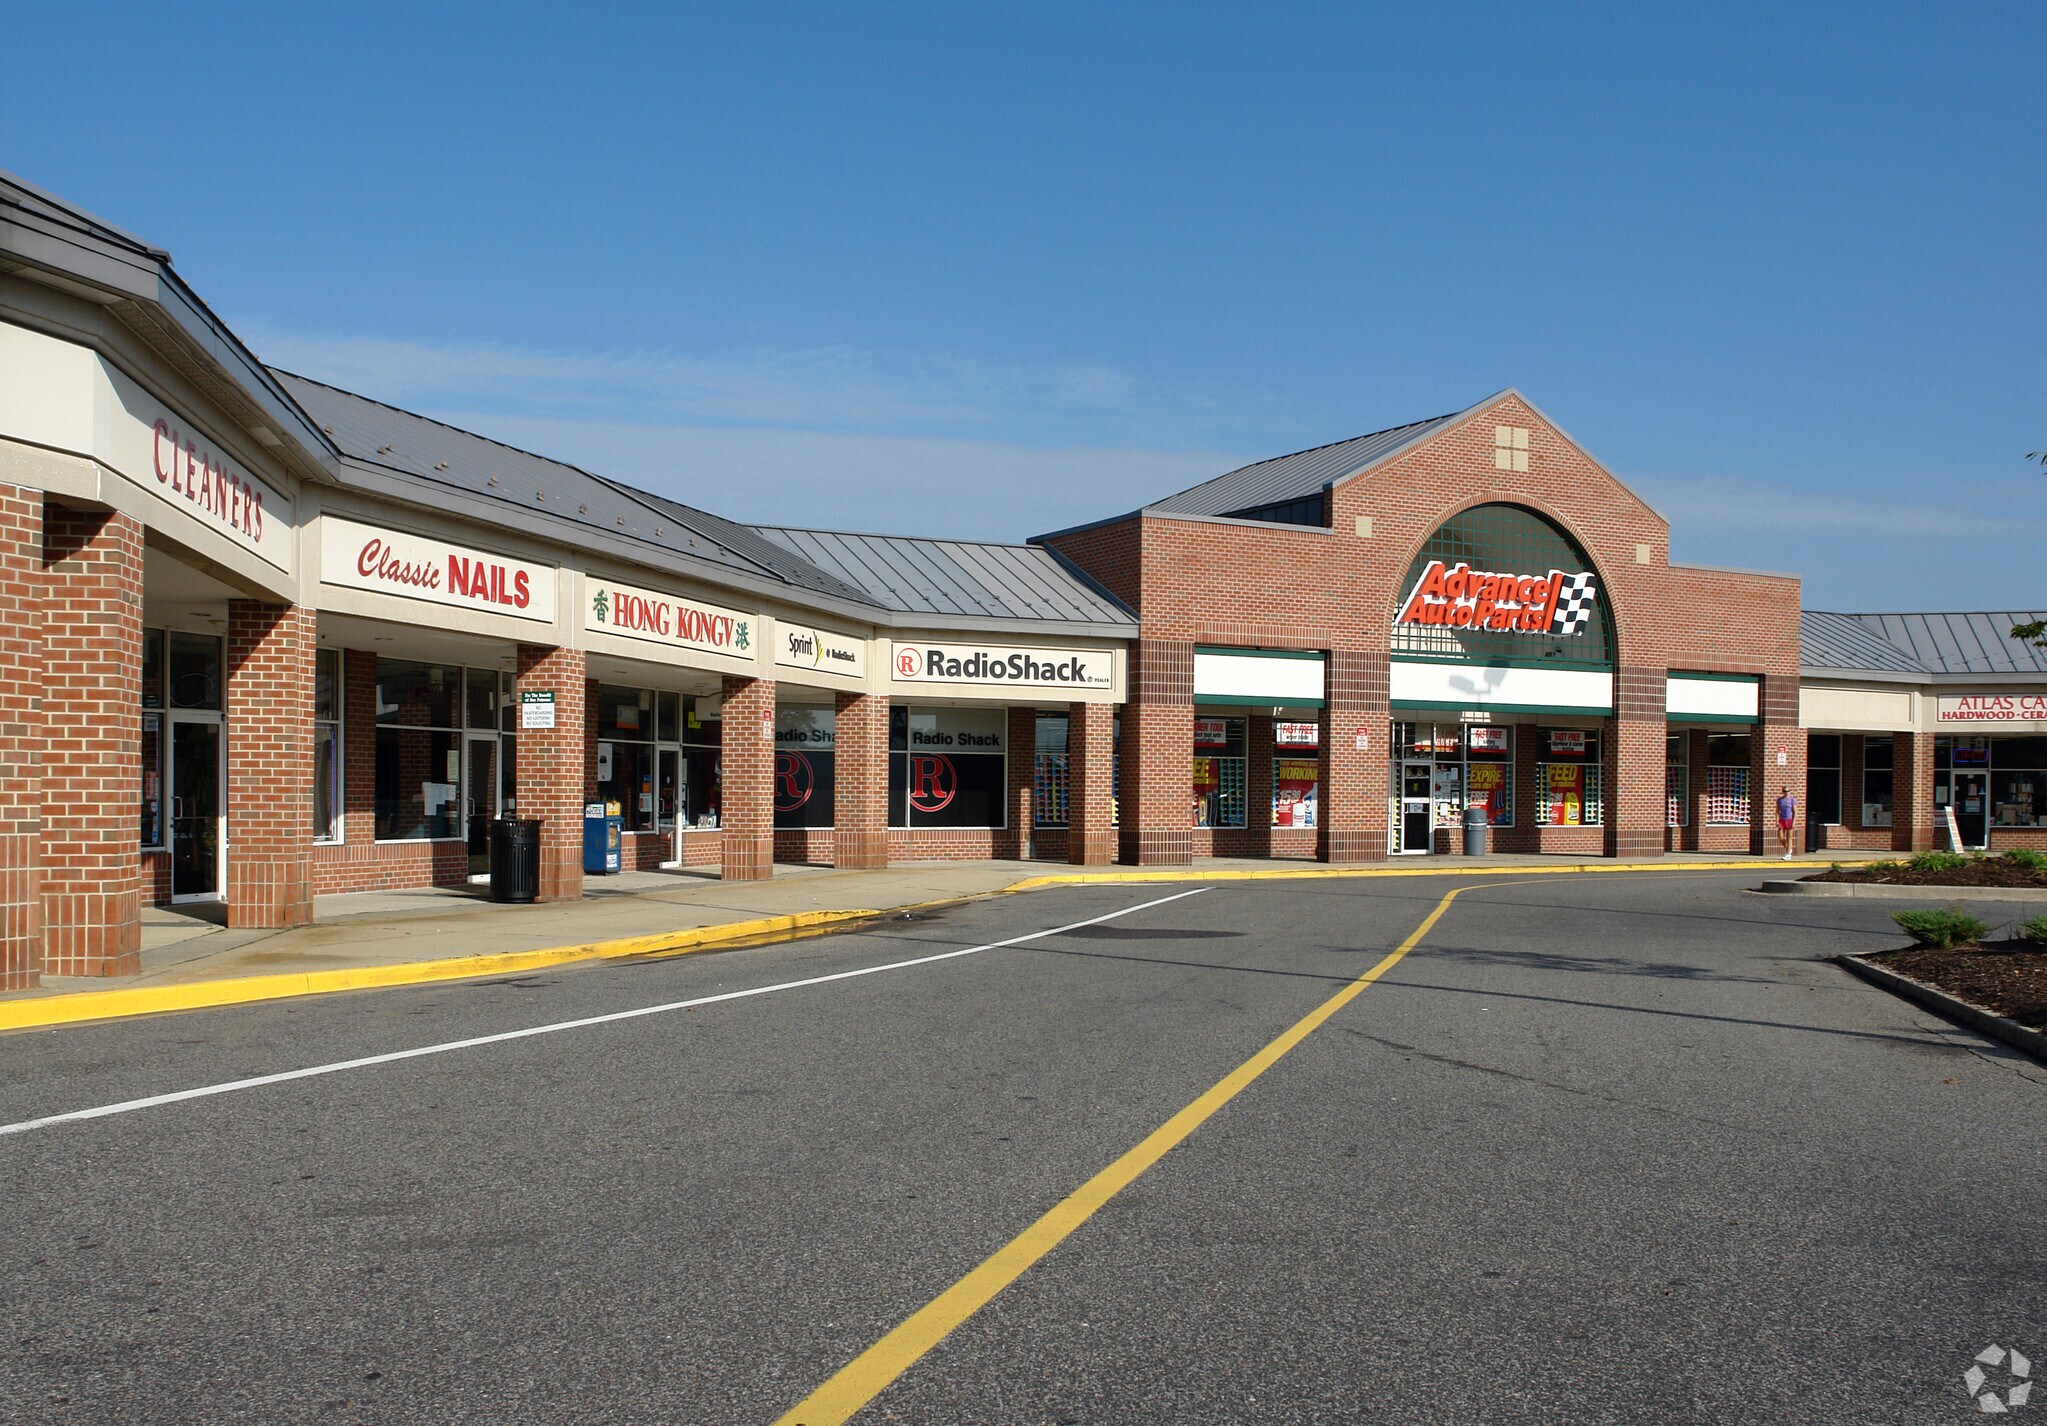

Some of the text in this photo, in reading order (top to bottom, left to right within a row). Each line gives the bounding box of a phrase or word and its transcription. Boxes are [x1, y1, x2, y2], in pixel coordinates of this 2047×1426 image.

[153, 418, 262, 543] CLEANERS
[357, 538, 530, 608] Classic NAILS
[1416, 563, 1550, 607] Advance
[593, 589, 609, 623] 香
[613, 592, 670, 636] HONG
[1400, 596, 1546, 631] Auto Parts
[735, 622, 750, 650] 港
[789, 633, 813, 658] Sprint
[927, 650, 1086, 682] RadioShack
[1942, 711, 2015, 719] HARDWOOD
[1958, 696, 2014, 710] ATLAS
[775, 729, 835, 742] adio Sha
[913, 732, 999, 746] Radio Shack
[911, 757, 948, 798] R
